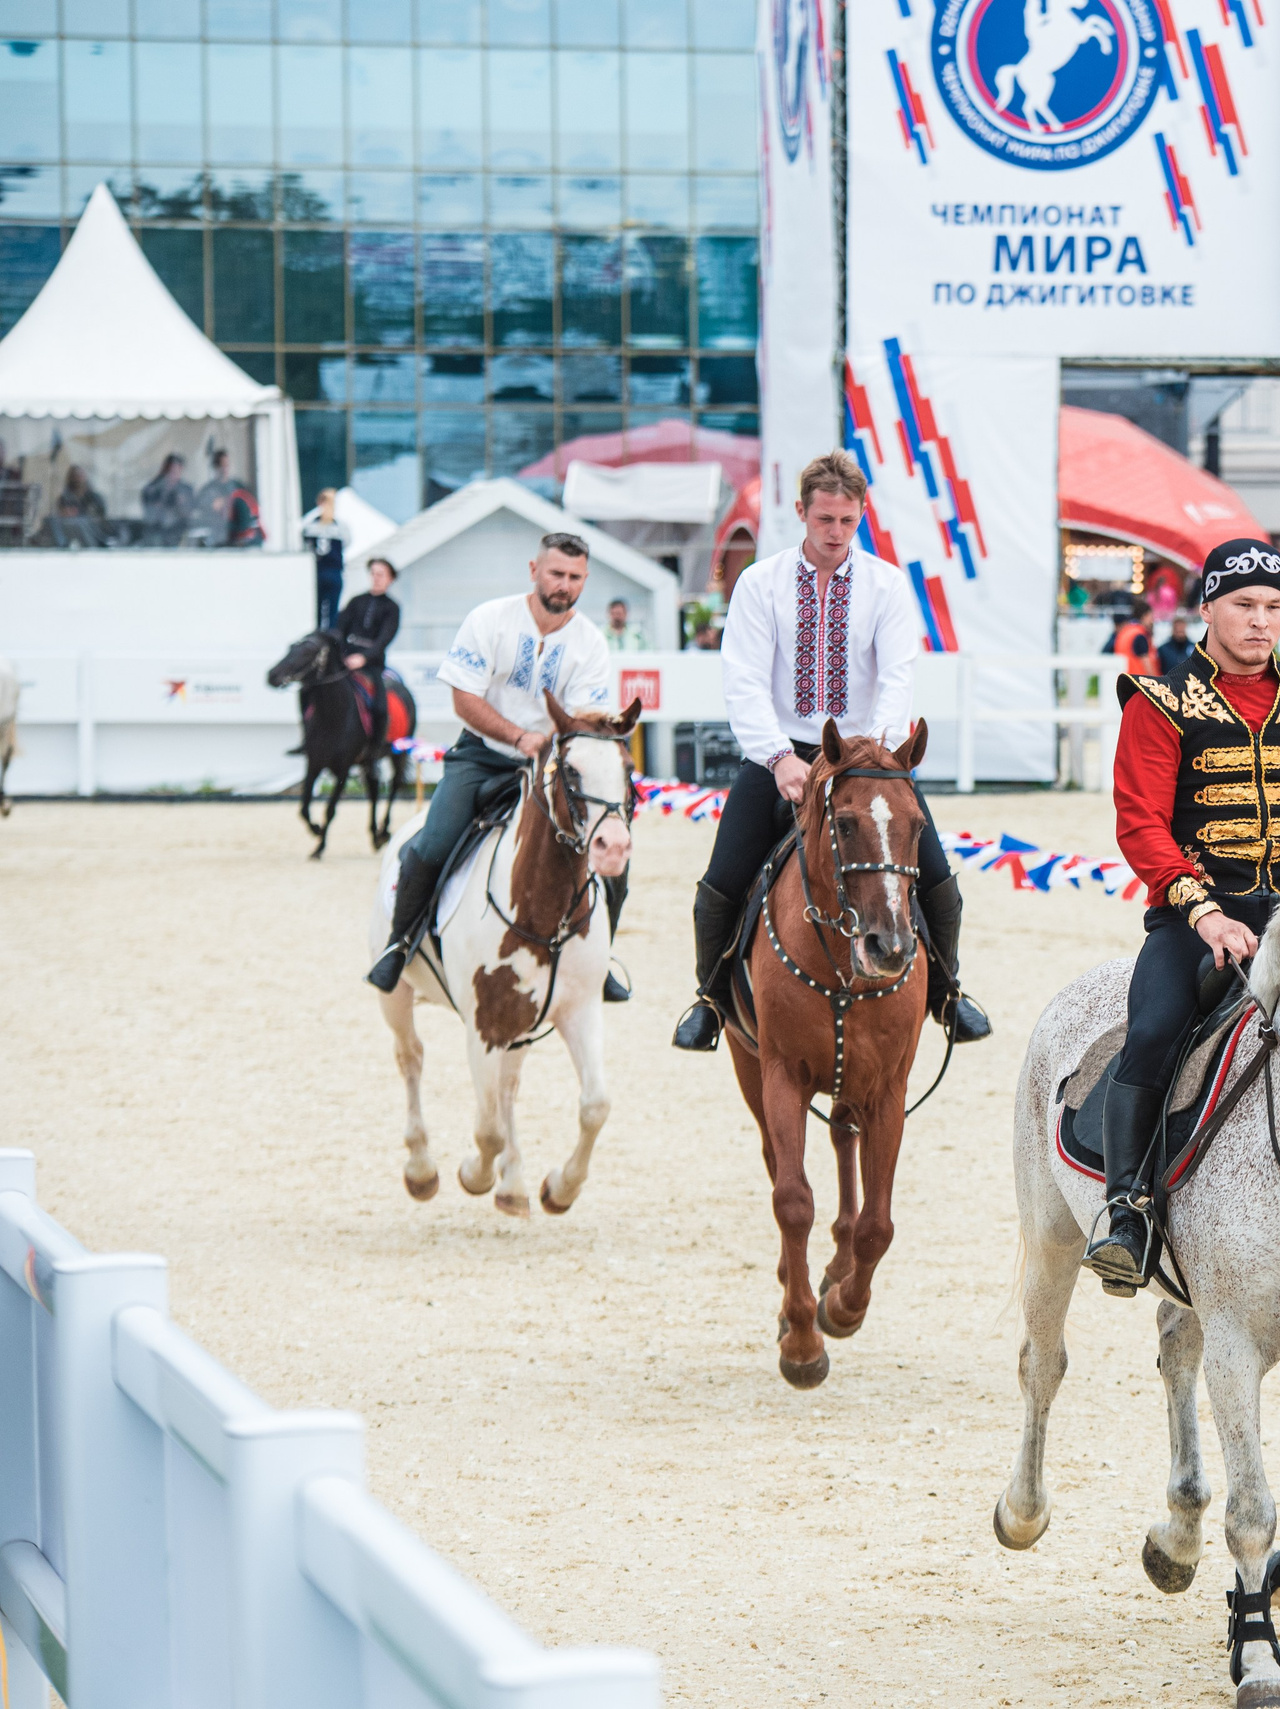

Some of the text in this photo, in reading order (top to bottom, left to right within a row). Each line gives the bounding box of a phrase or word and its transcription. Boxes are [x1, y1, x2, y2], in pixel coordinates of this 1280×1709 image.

[930, 203, 1122, 226] ЧЕМПИОНАТ
[992, 235, 1148, 274] МИРА
[933, 283, 1194, 307] ПО ДЖИГИТОВКЕ
